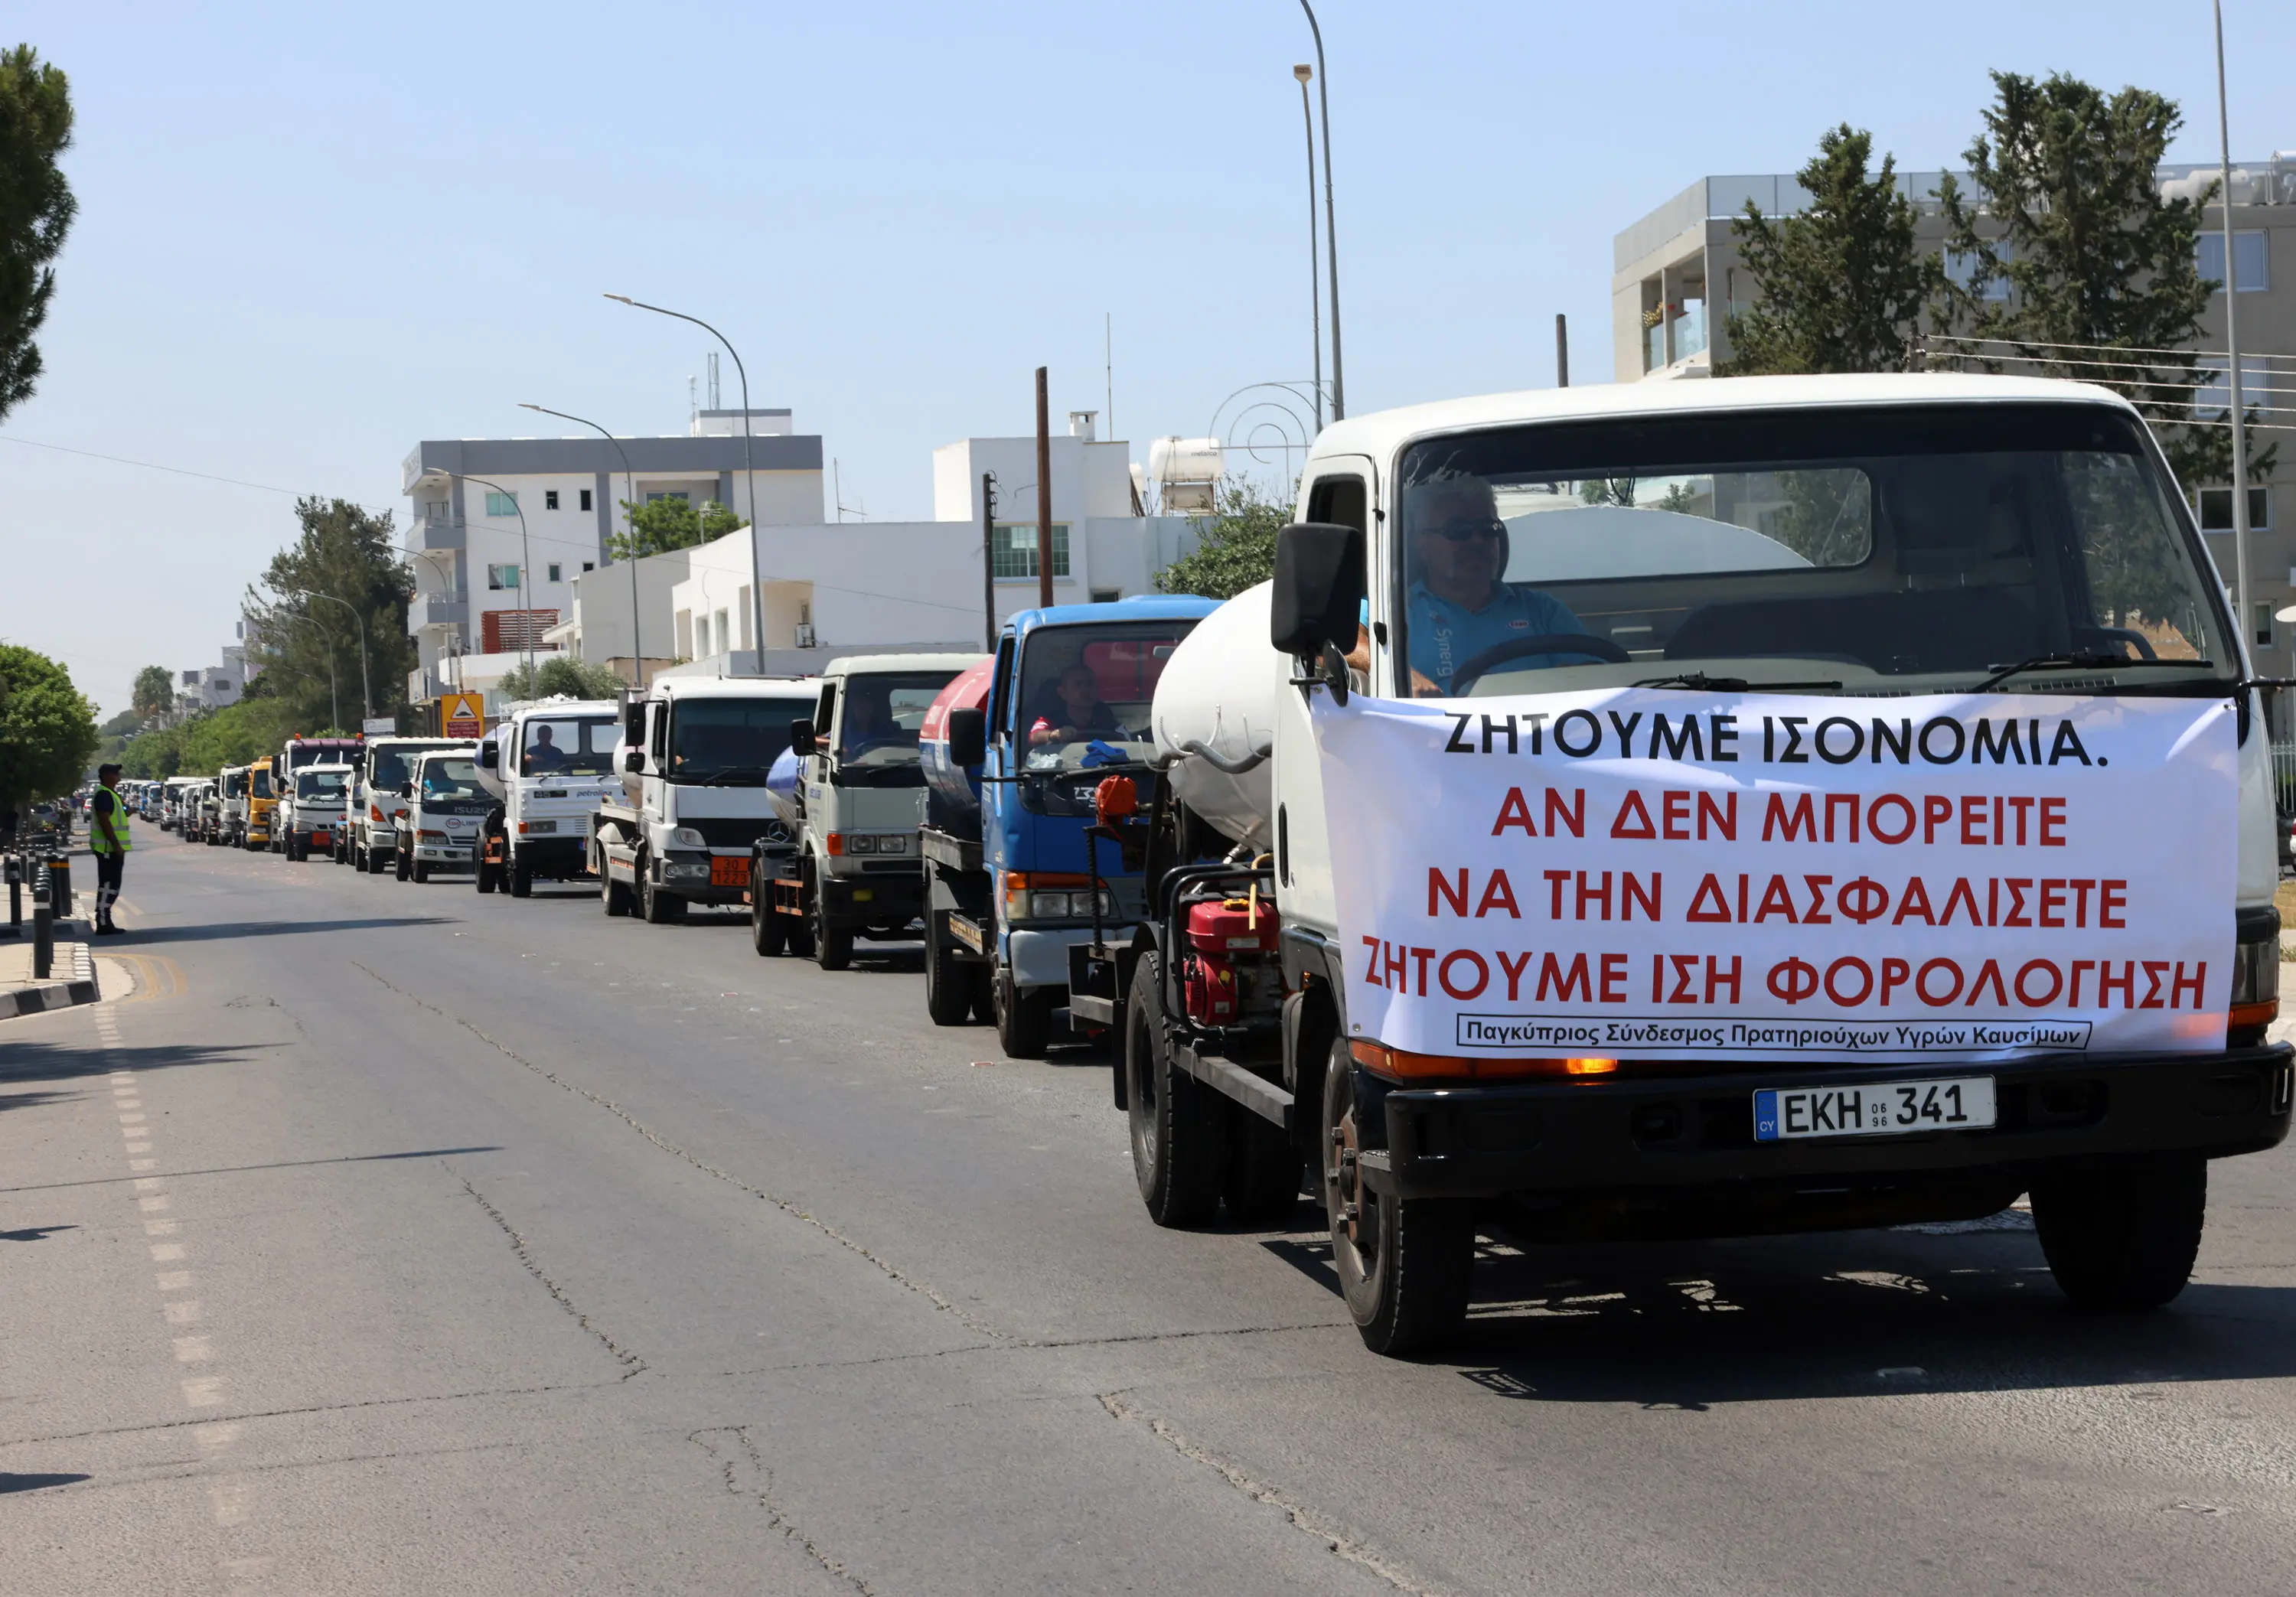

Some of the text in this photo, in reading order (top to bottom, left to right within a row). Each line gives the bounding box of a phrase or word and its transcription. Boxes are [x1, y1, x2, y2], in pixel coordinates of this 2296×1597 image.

[1444, 709, 2108, 767] ΖΗΤΟΥΜΕ ΙΣΟΝΟΜΙΑ.
[454, 806, 489, 814] ISUZU
[1492, 787, 2066, 846] ΑΝ ΔΕΝ ΜΠΟΡΕΙΤΕ
[723, 859, 739, 870] 30
[716, 873, 748, 884] 1223
[1428, 867, 2127, 929] ΝΑ ΤΗΝ ΔΙΑΣΦΑΛΙΣΕΤΕ
[1362, 935, 2206, 1009] ΖΗΤΟΥΜΕ ΙΣΗ ΦΟΡΟΛΟΓΗΣΗ
[1467, 1021, 2081, 1049] Παγκύπριος Σύνδεσμος Πρατηριούχων Υγρών Καυσίμων
[1784, 1084, 1968, 1134] EKH 341
[1871, 1103, 1887, 1114] 06
[1760, 1120, 1775, 1133] CY
[1872, 1116, 1888, 1127] 96
